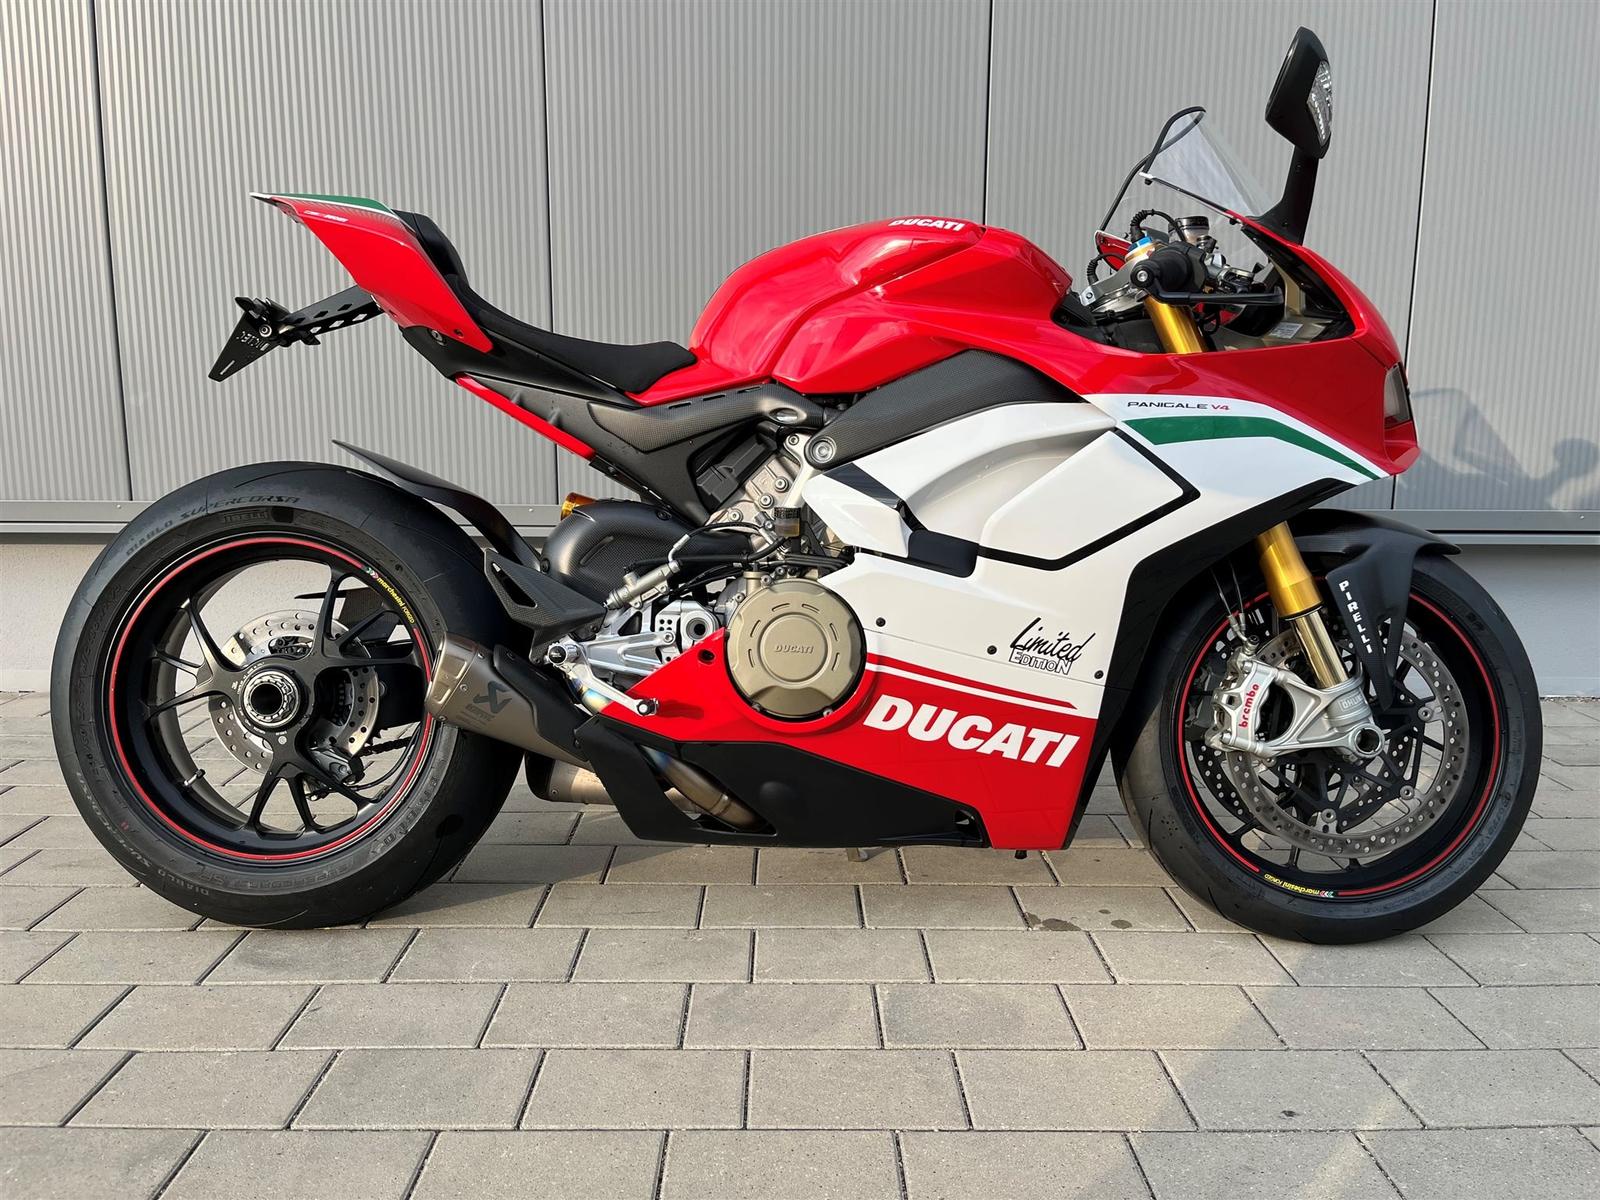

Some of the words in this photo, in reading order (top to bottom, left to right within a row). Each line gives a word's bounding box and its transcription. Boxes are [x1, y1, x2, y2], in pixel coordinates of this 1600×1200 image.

[888, 218, 965, 231] DUCATI
[1127, 401, 1208, 410] PANIGALE
[126, 520, 173, 557] DIABLO
[180, 495, 301, 520] SUPERCORSA
[377, 578, 405, 607] marchesini
[1338, 580, 1373, 654] PIRELLI
[774, 644, 815, 654] DUCATI
[1010, 617, 1096, 662] Limited
[1009, 645, 1073, 675] EDITION
[1238, 683, 1260, 728] brembo
[863, 694, 1081, 768] DUCATI
[157, 868, 210, 897] DIABLO
[1283, 881, 1320, 895] marchesini
